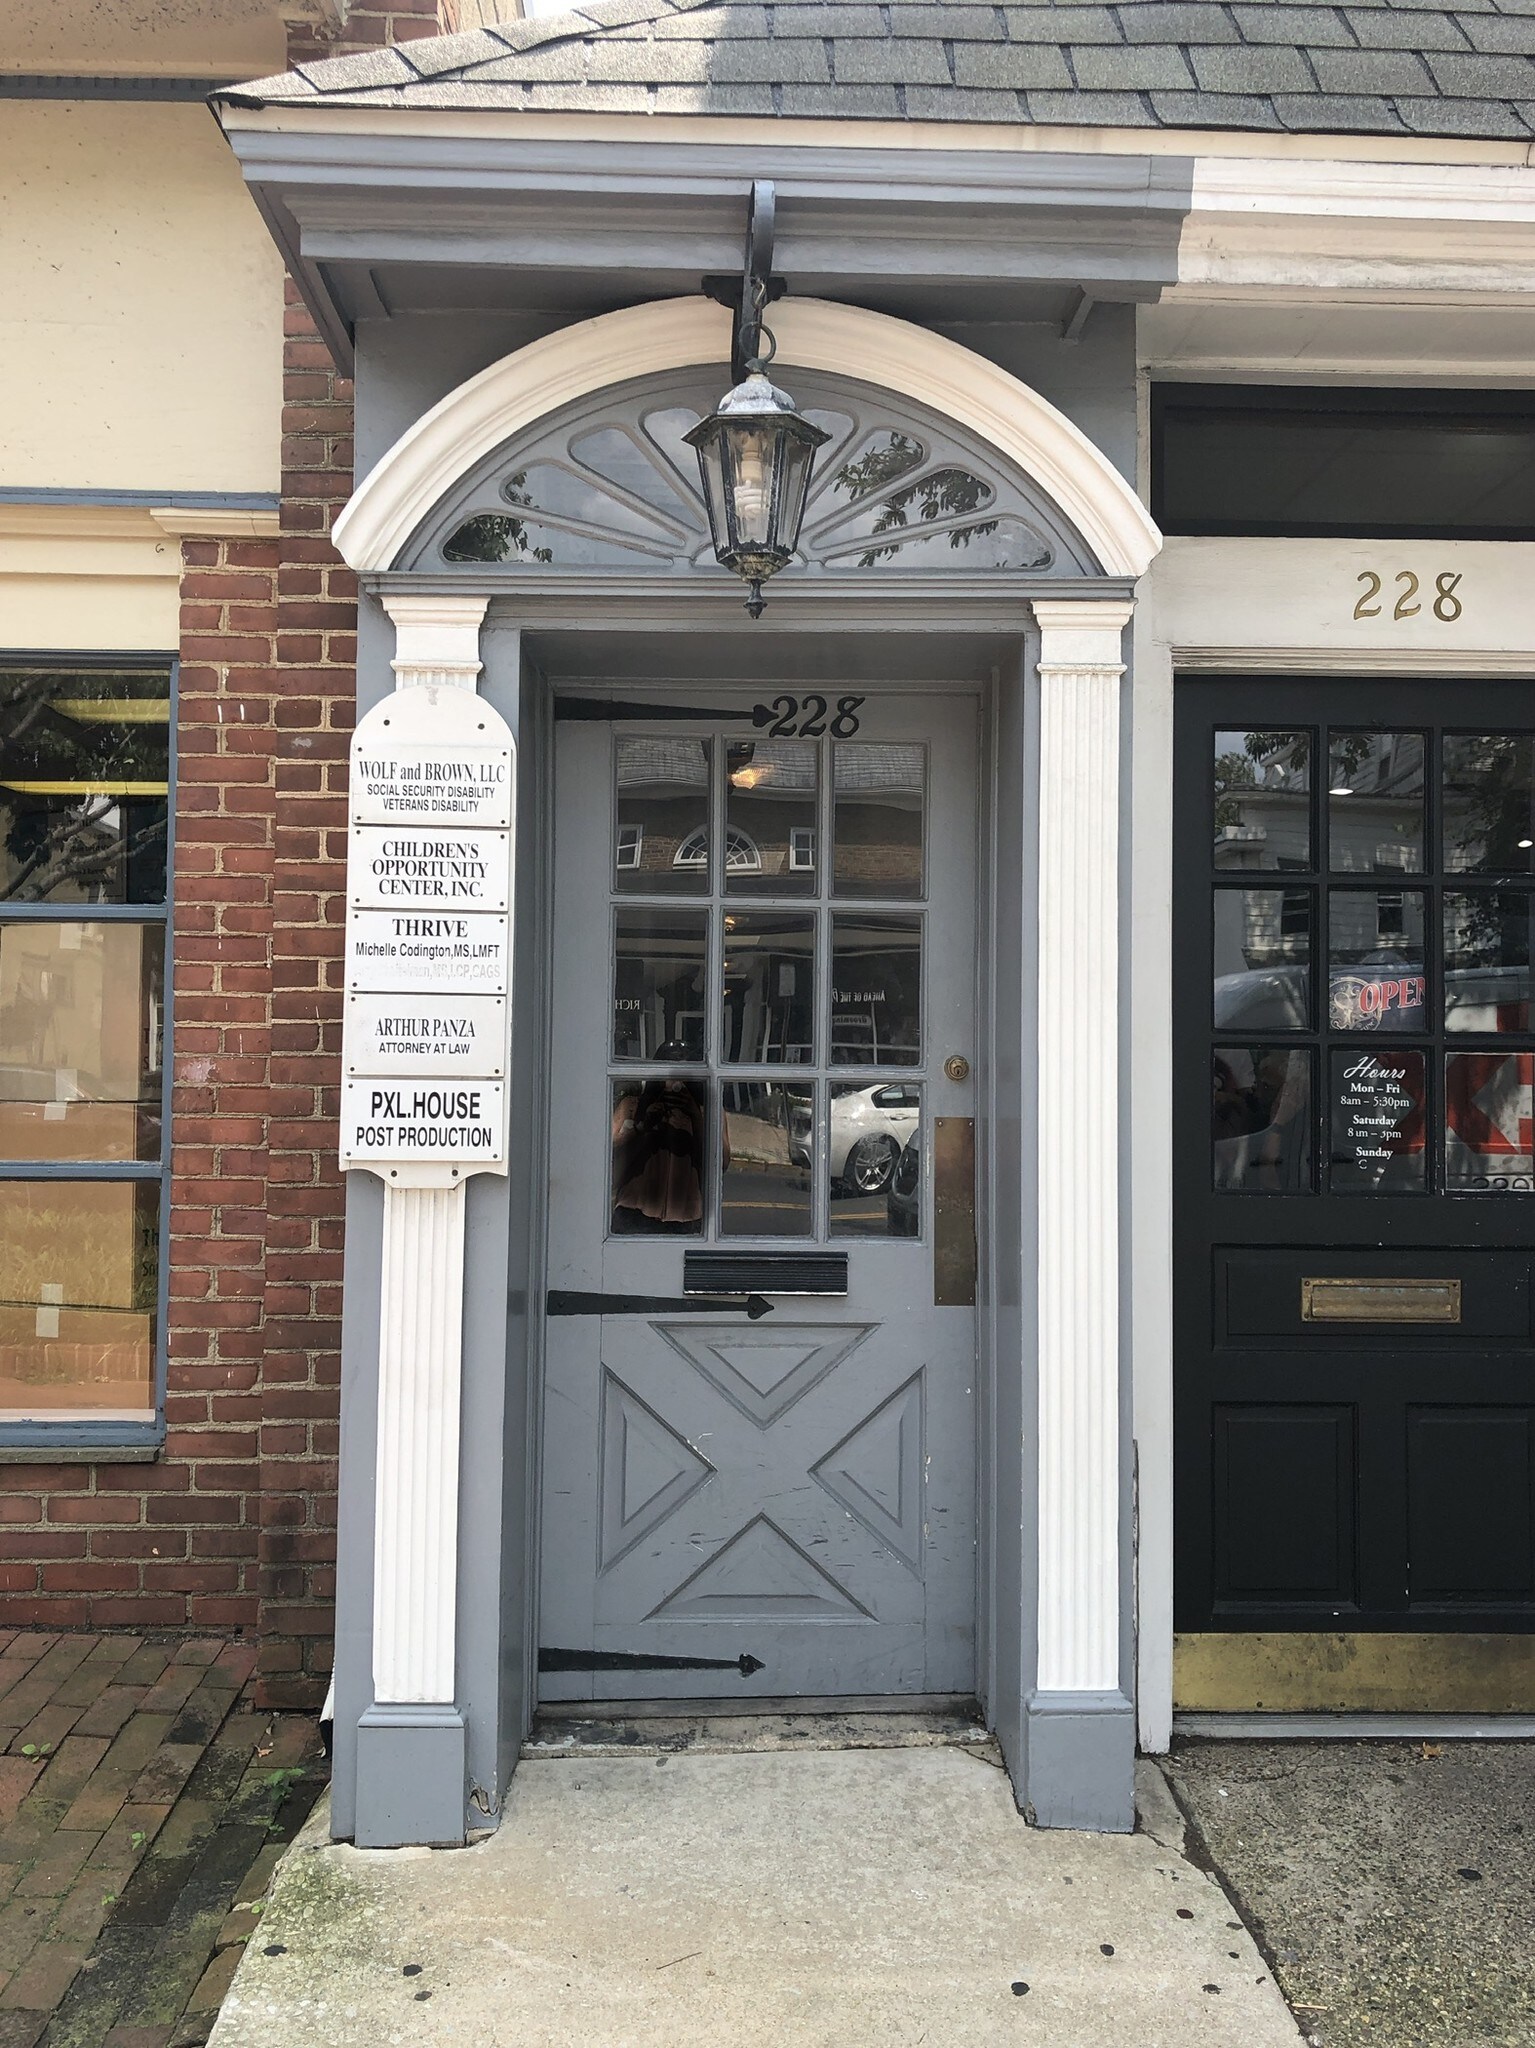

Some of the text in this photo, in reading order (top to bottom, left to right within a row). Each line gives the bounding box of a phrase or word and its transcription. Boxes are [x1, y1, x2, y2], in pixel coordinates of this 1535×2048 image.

[1354, 571, 1463, 622] 228
[769, 695, 866, 738] 228
[358, 760, 506, 784] WOLF and BROWN, LLC
[367, 783, 496, 799] SOCIAL SECURITY DISABILITY
[382, 798, 480, 813] VETERANS DISABILITY
[382, 840, 479, 859] CHILDREN'S
[372, 858, 489, 878] OPPORTUNITY
[378, 878, 484, 899] CENTER, INC.
[392, 918, 469, 938] THRIVE
[355, 942, 397, 956] Michelle
[375, 1018, 476, 1037] ARTHUR PANZA
[379, 1042, 471, 1055] ATTORNEY AT LAW
[1343, 1056, 1406, 1079] Hours
[1350, 1082, 1375, 1093] Mon
[1386, 1083, 1400, 1094] Fri
[371, 1091, 481, 1119] PXL.HOUSE
[1340, 1095, 1361, 1105] 8am
[1373, 1096, 1410, 1109] 5:30pm
[1352, 1114, 1397, 1128] Saturday
[356, 1126, 492, 1147] POST PRODUCTION
[1355, 1146, 1394, 1160] Sunday
